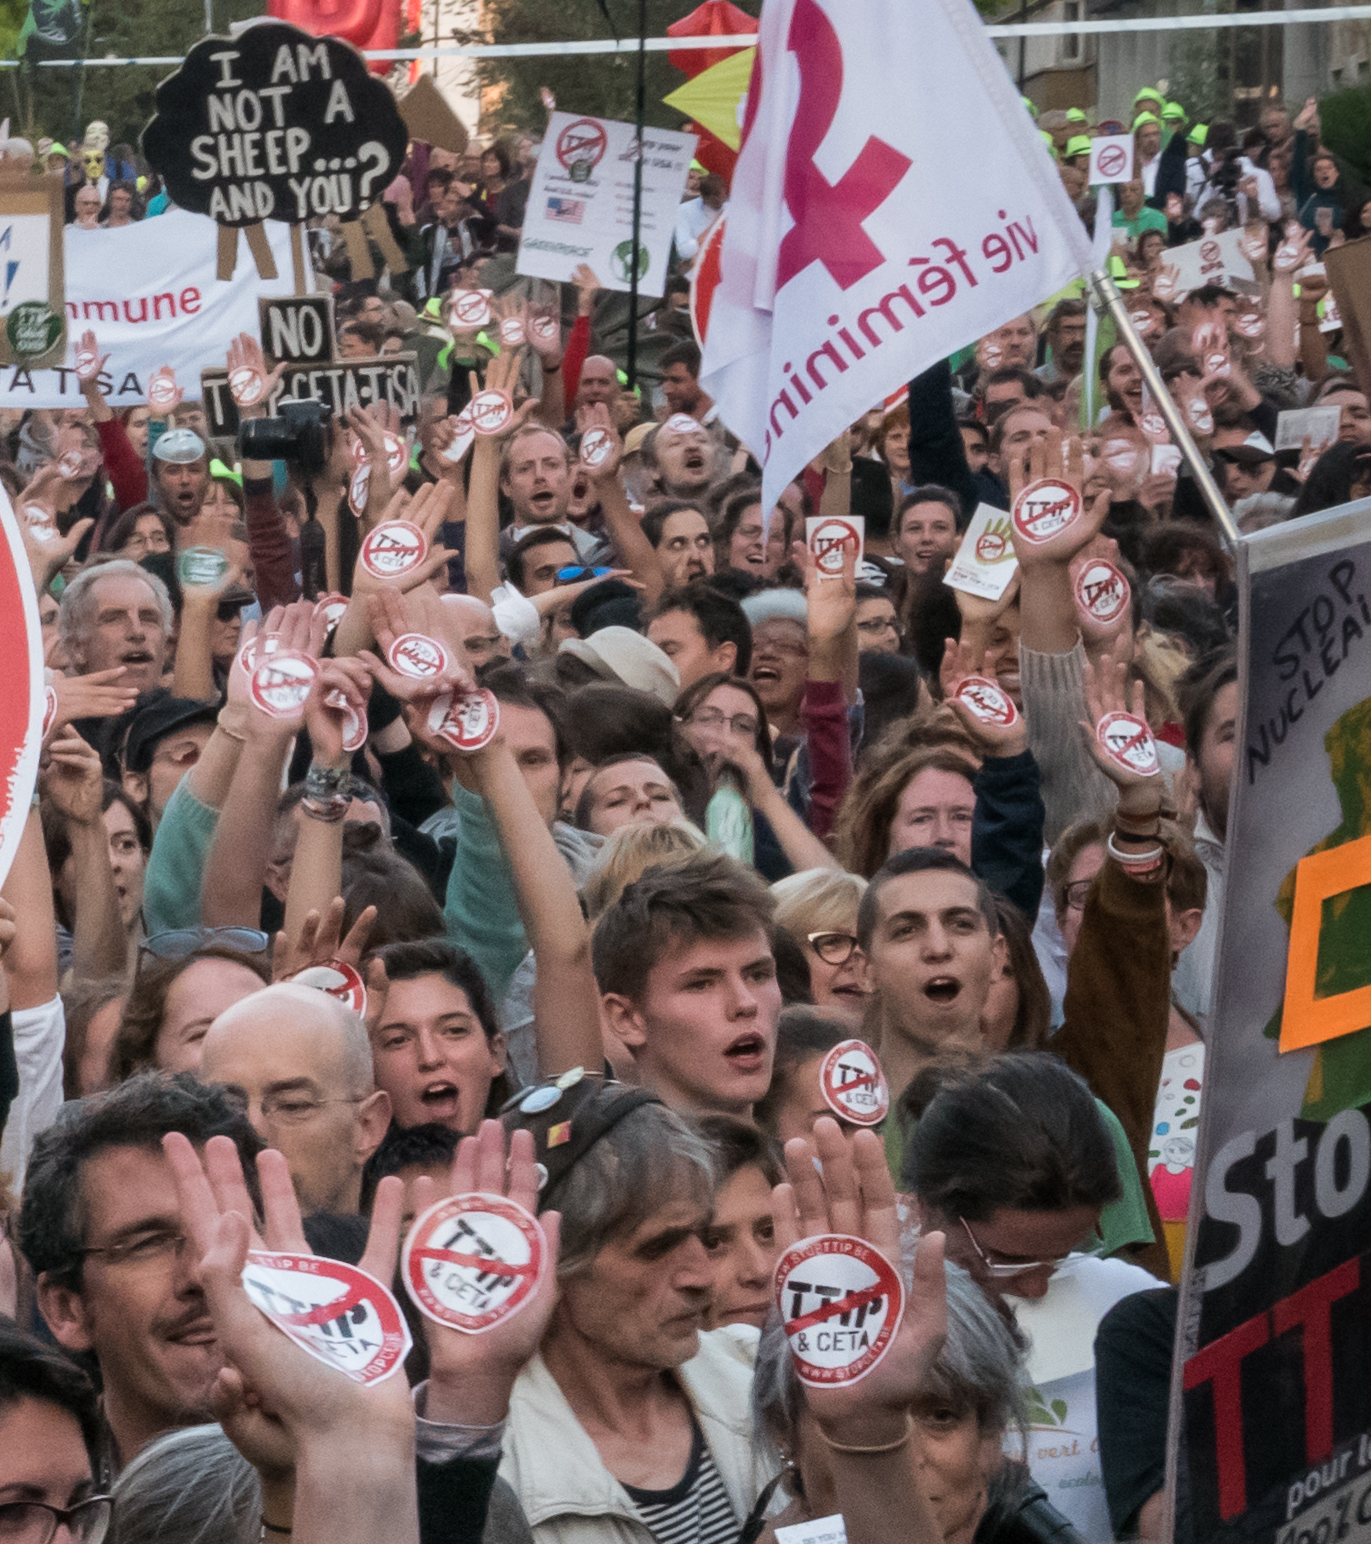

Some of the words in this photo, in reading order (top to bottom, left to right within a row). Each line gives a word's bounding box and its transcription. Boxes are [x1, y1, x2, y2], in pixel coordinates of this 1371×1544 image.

[209, 51, 243, 88] I
[271, 43, 332, 83] AM
[208, 85, 293, 132] NOT
[324, 79, 356, 124] A
[209, 181, 275, 221] AND
[268, 305, 323, 358] NO
[1027, 501, 1072, 518] TTIP
[1272, 558, 1356, 681] STOP
[443, 1219, 516, 1293] TTIP
[788, 1280, 882, 1328] TTIP
[799, 1332, 810, 1352] &
[816, 1331, 871, 1352] CETA
[1286, 1450, 1353, 1520] pour
